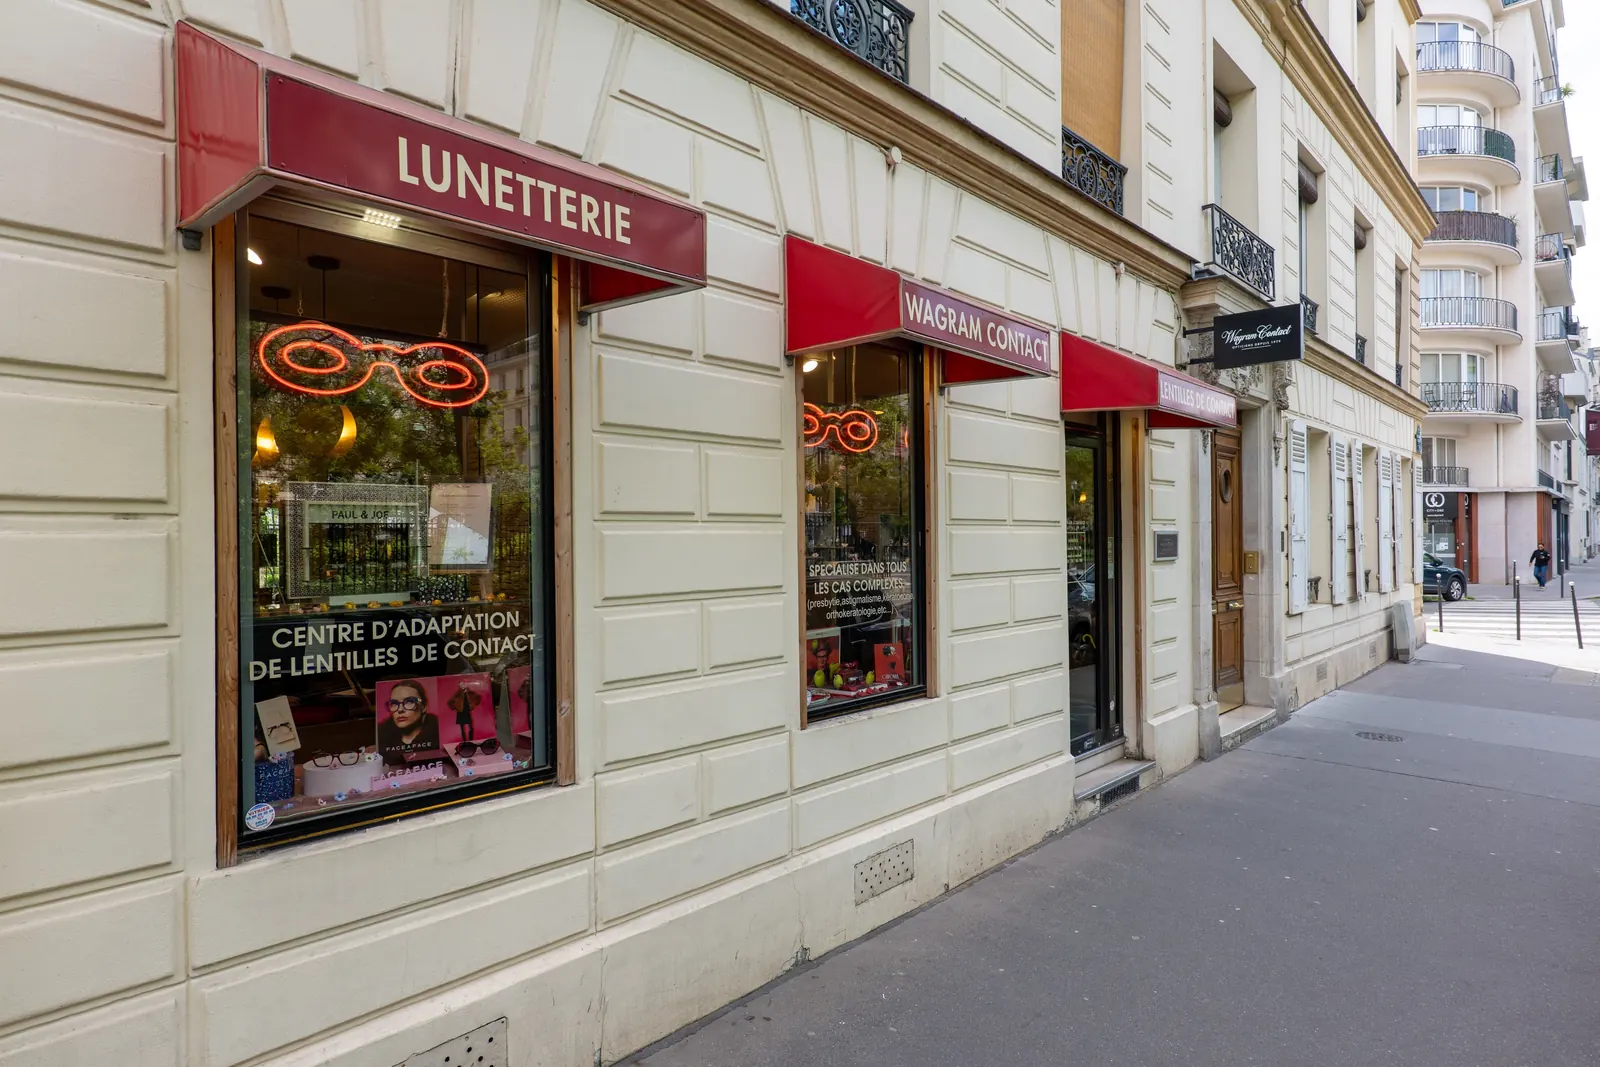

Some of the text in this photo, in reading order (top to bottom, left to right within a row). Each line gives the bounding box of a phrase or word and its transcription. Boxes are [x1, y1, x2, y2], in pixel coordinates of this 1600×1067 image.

[398, 136, 631, 245] LUNETTERIE
[905, 291, 1048, 363] WAGRAM CONTACT
[1220, 324, 1292, 345] Wagram Contact
[1160, 380, 1235, 419] LENTILLES DE CONTACT
[331, 510, 390, 520] PAUL & JOE
[809, 561, 907, 577] SPECIALISE DANS TOUS
[814, 577, 904, 595] LES CAS COMPLEXES
[271, 610, 520, 649] CENTRE D'ADAPTATION
[249, 633, 536, 682] DE LENTILLES DE CONTACT
[386, 741, 432, 752] FACEAFACE
